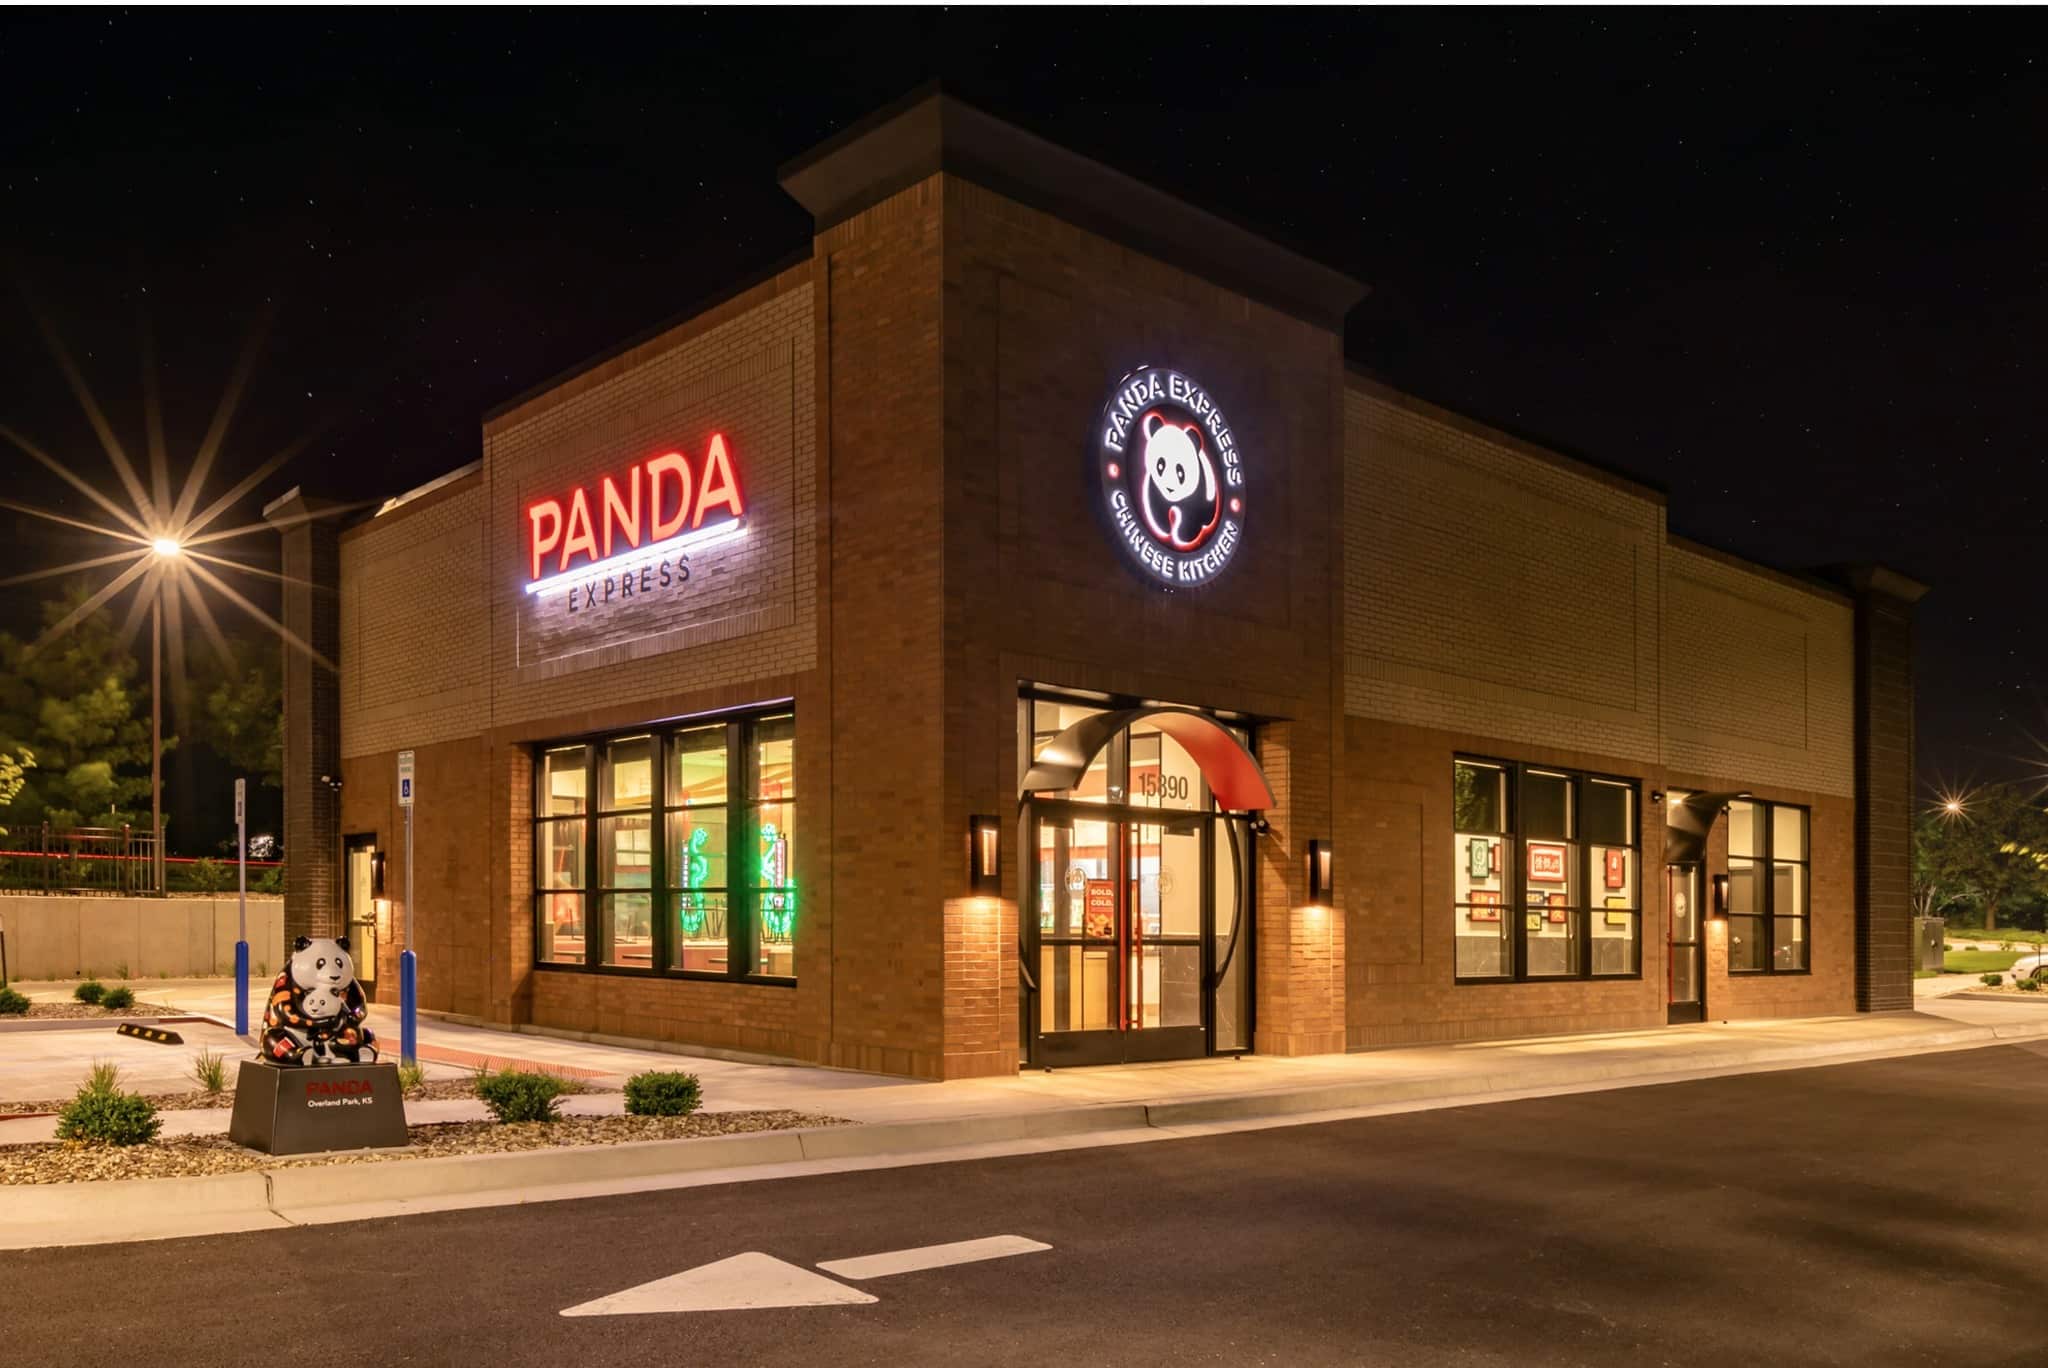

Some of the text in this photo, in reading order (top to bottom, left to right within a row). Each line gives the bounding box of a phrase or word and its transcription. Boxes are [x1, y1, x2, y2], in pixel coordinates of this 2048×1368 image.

[1105, 373, 1242, 486] PANDA EXPRESS
[528, 432, 743, 581] PANDA
[1111, 489, 1239, 581] CHINESE KITCHEN
[568, 553, 690, 613] EXPRESS
[1138, 772, 1188, 800] 15890
[306, 1080, 373, 1099] PANDA
[307, 1099, 341, 1107] Overland
[342, 1098, 361, 1106] Park,
